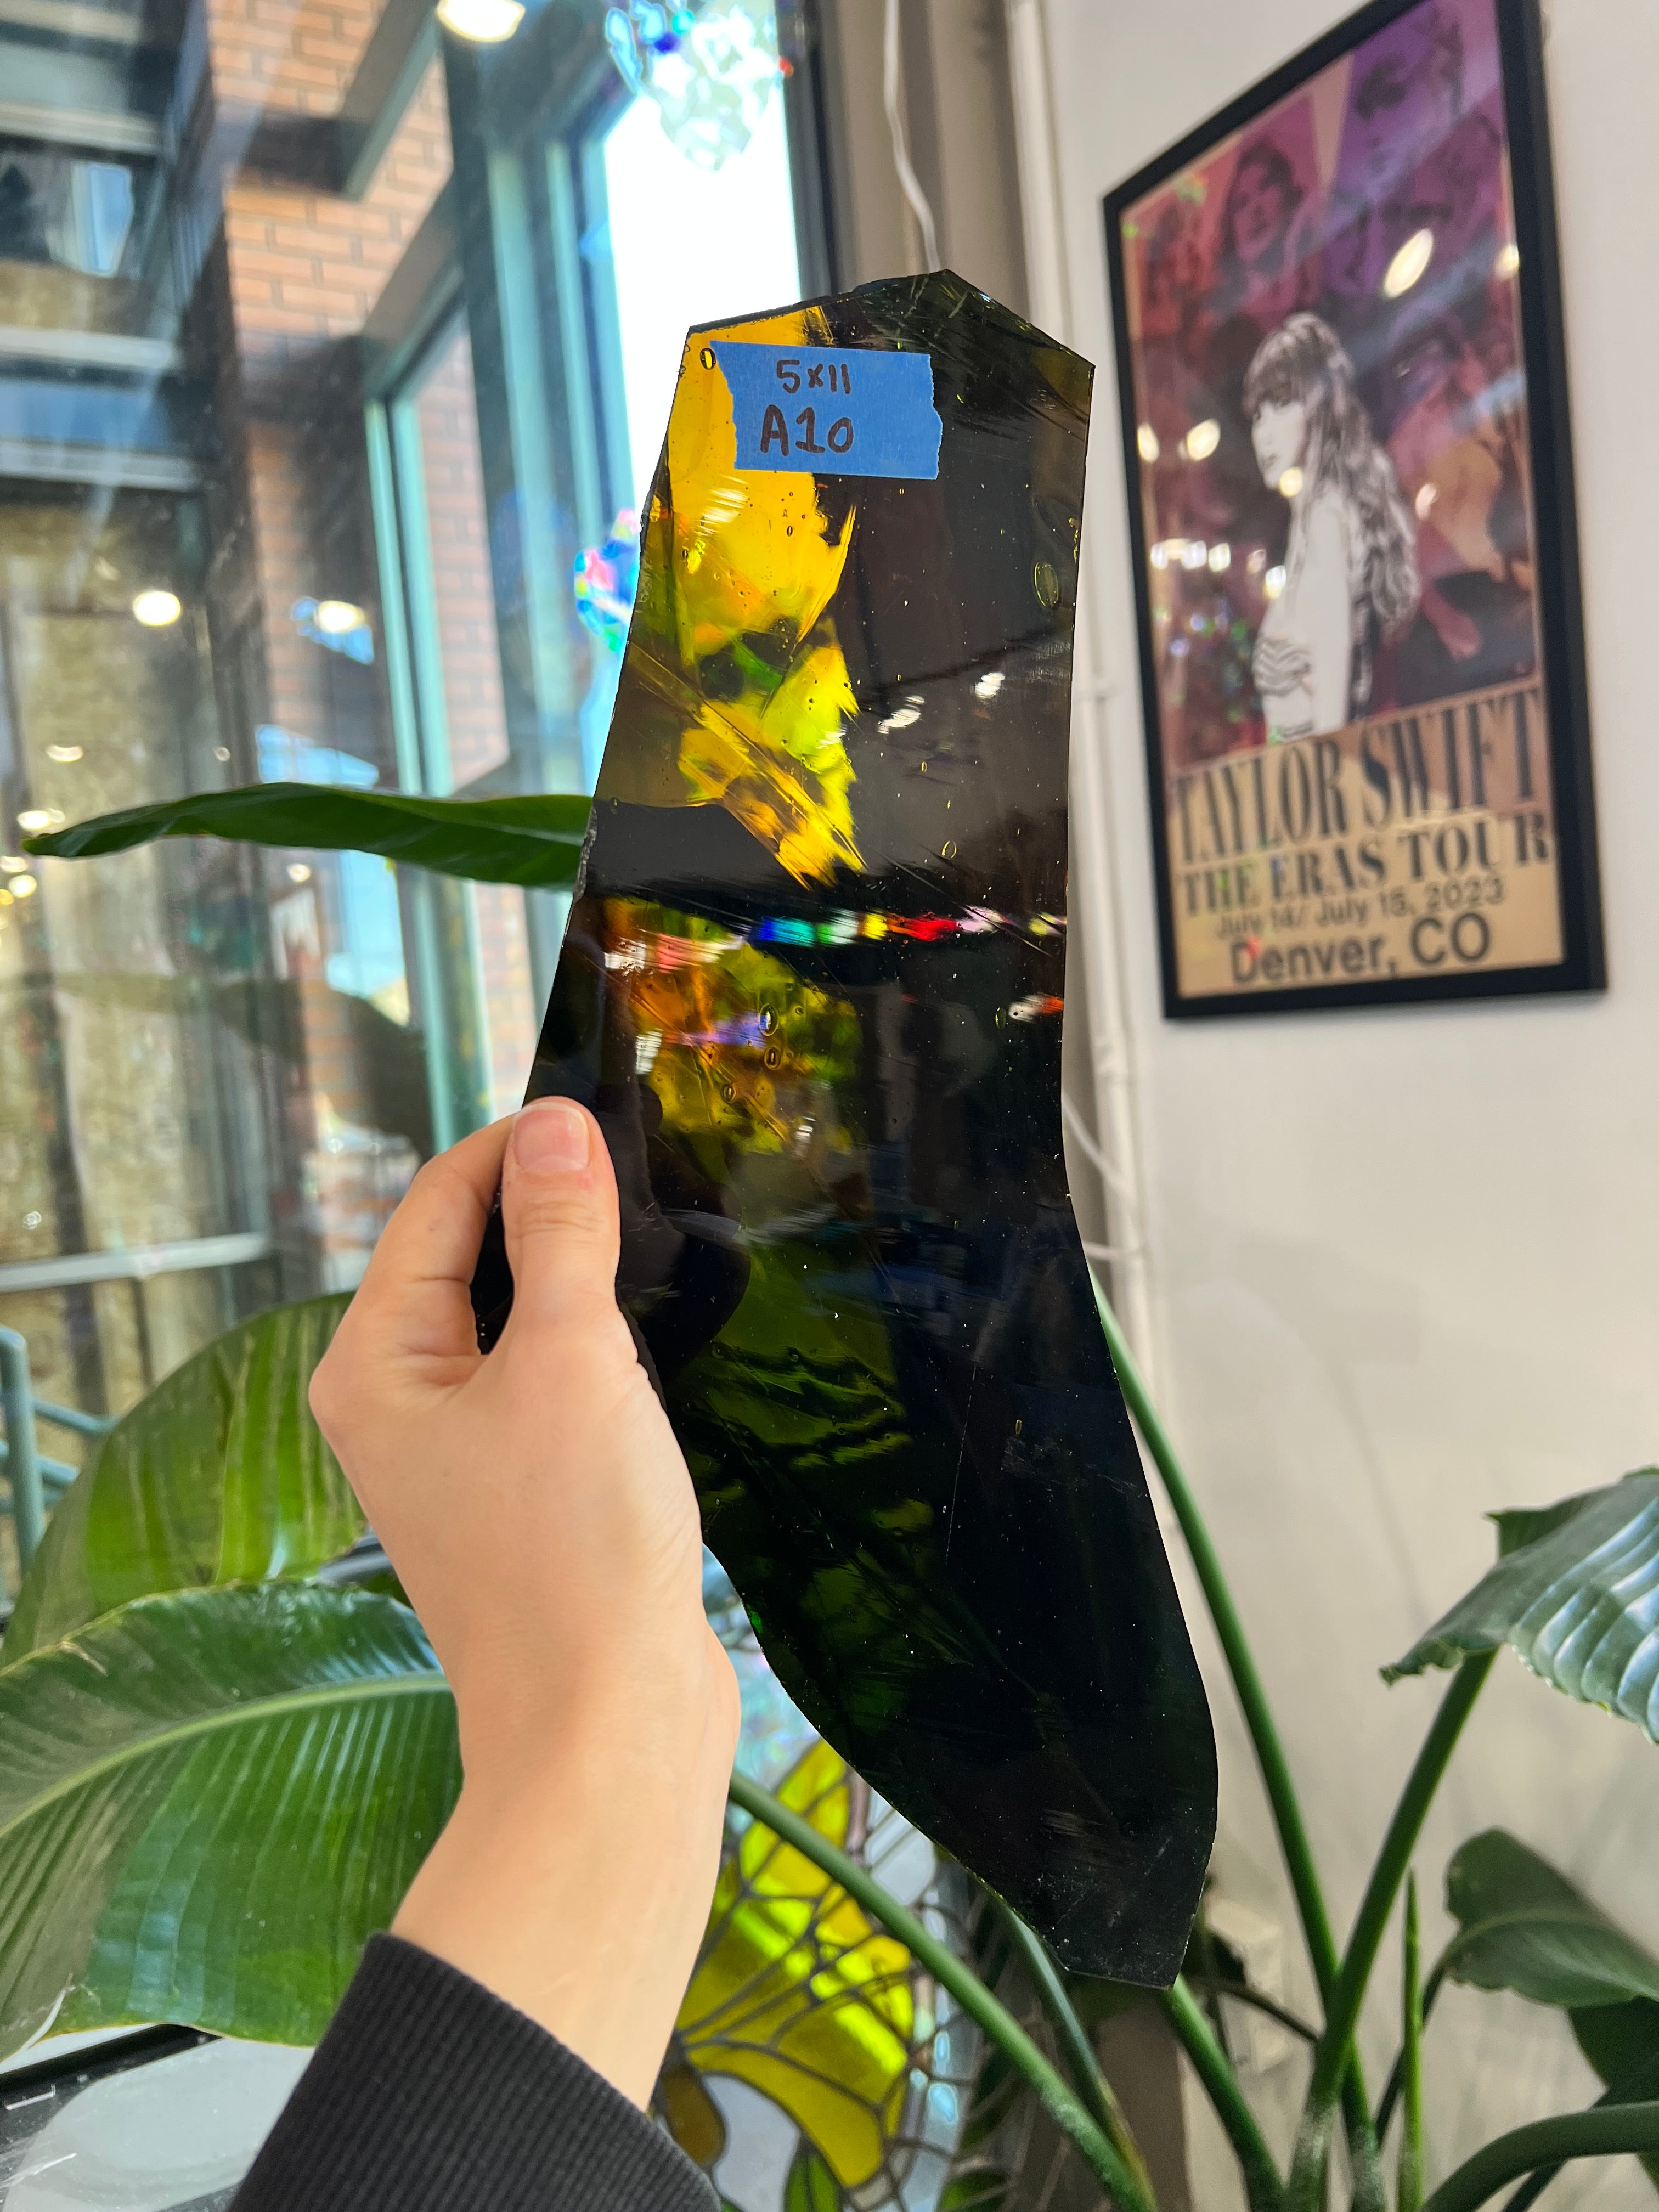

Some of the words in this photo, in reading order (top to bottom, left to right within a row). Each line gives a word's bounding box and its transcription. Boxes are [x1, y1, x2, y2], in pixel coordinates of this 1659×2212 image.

[759, 404, 854, 456] A10
[1174, 735, 1347, 865] TAYLOR
[1359, 686, 1543, 830] SWIFT
[1180, 857, 1263, 916] THE
[1267, 832, 1387, 902] ERAS
[1397, 811, 1550, 883] TOUR
[1317, 895, 1369, 929] July
[1425, 877, 1505, 913] 2023
[1231, 935, 1399, 984] Denver,
[1408, 911, 1493, 967] CO
